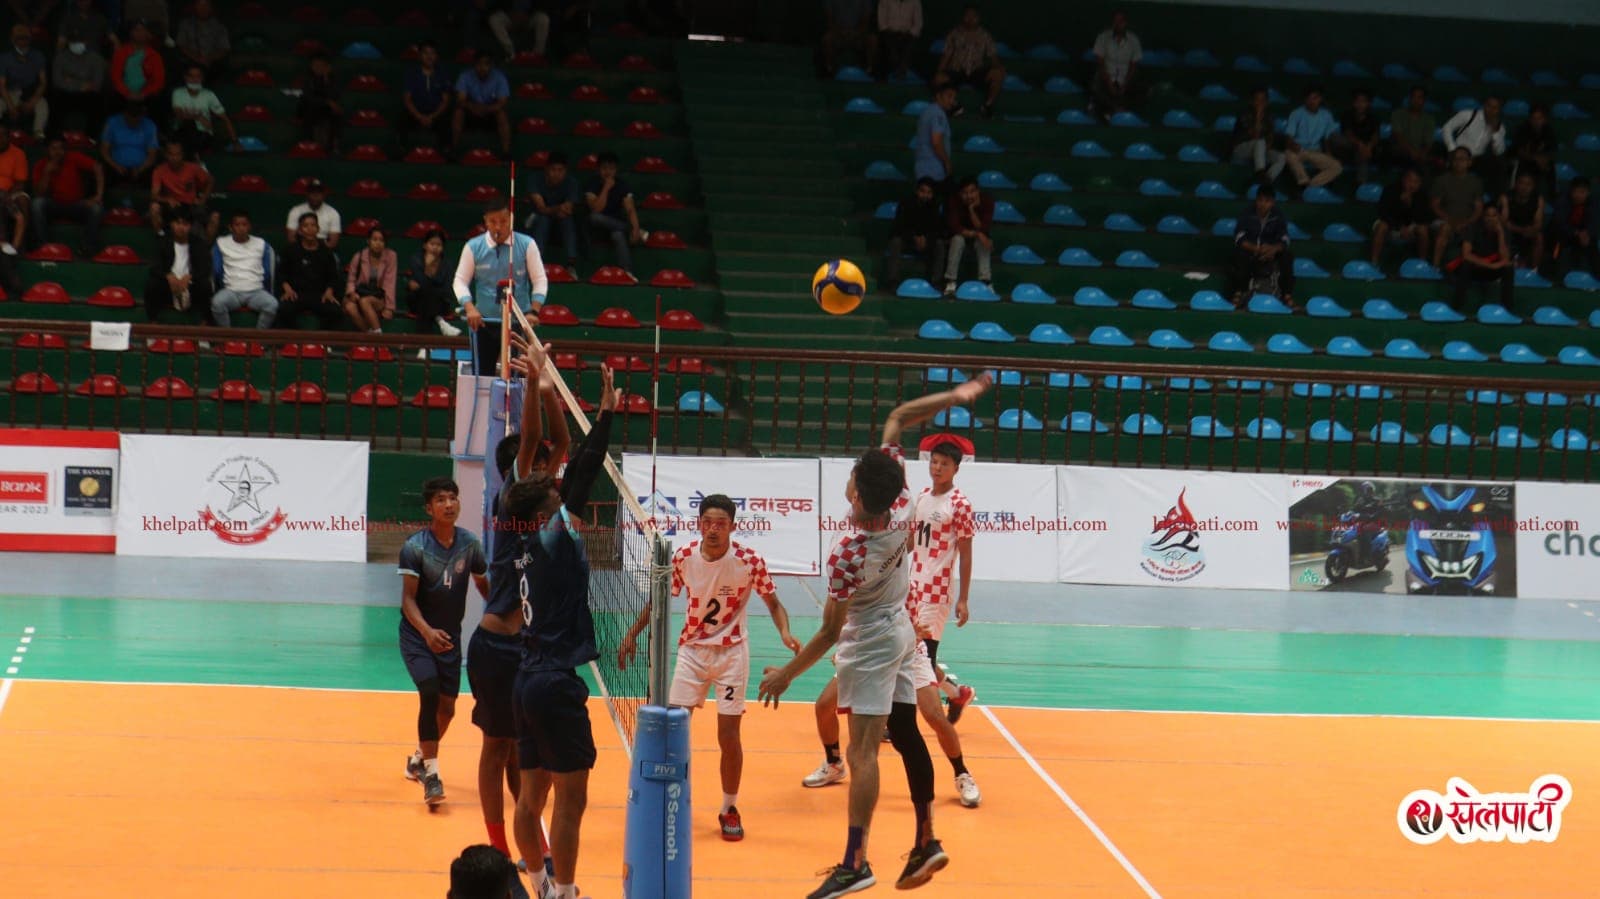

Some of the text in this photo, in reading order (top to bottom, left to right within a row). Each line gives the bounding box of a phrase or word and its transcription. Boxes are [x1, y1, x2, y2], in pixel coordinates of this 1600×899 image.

[22, 505, 49, 514] 2023
[749, 497, 813, 517] लाइफ
[917, 520, 931, 548] 11
[443, 568, 452, 590] 4
[519, 572, 533, 627] 8
[703, 598, 721, 626] 2
[724, 685, 735, 701] 2
[667, 801, 679, 861] Senoh
